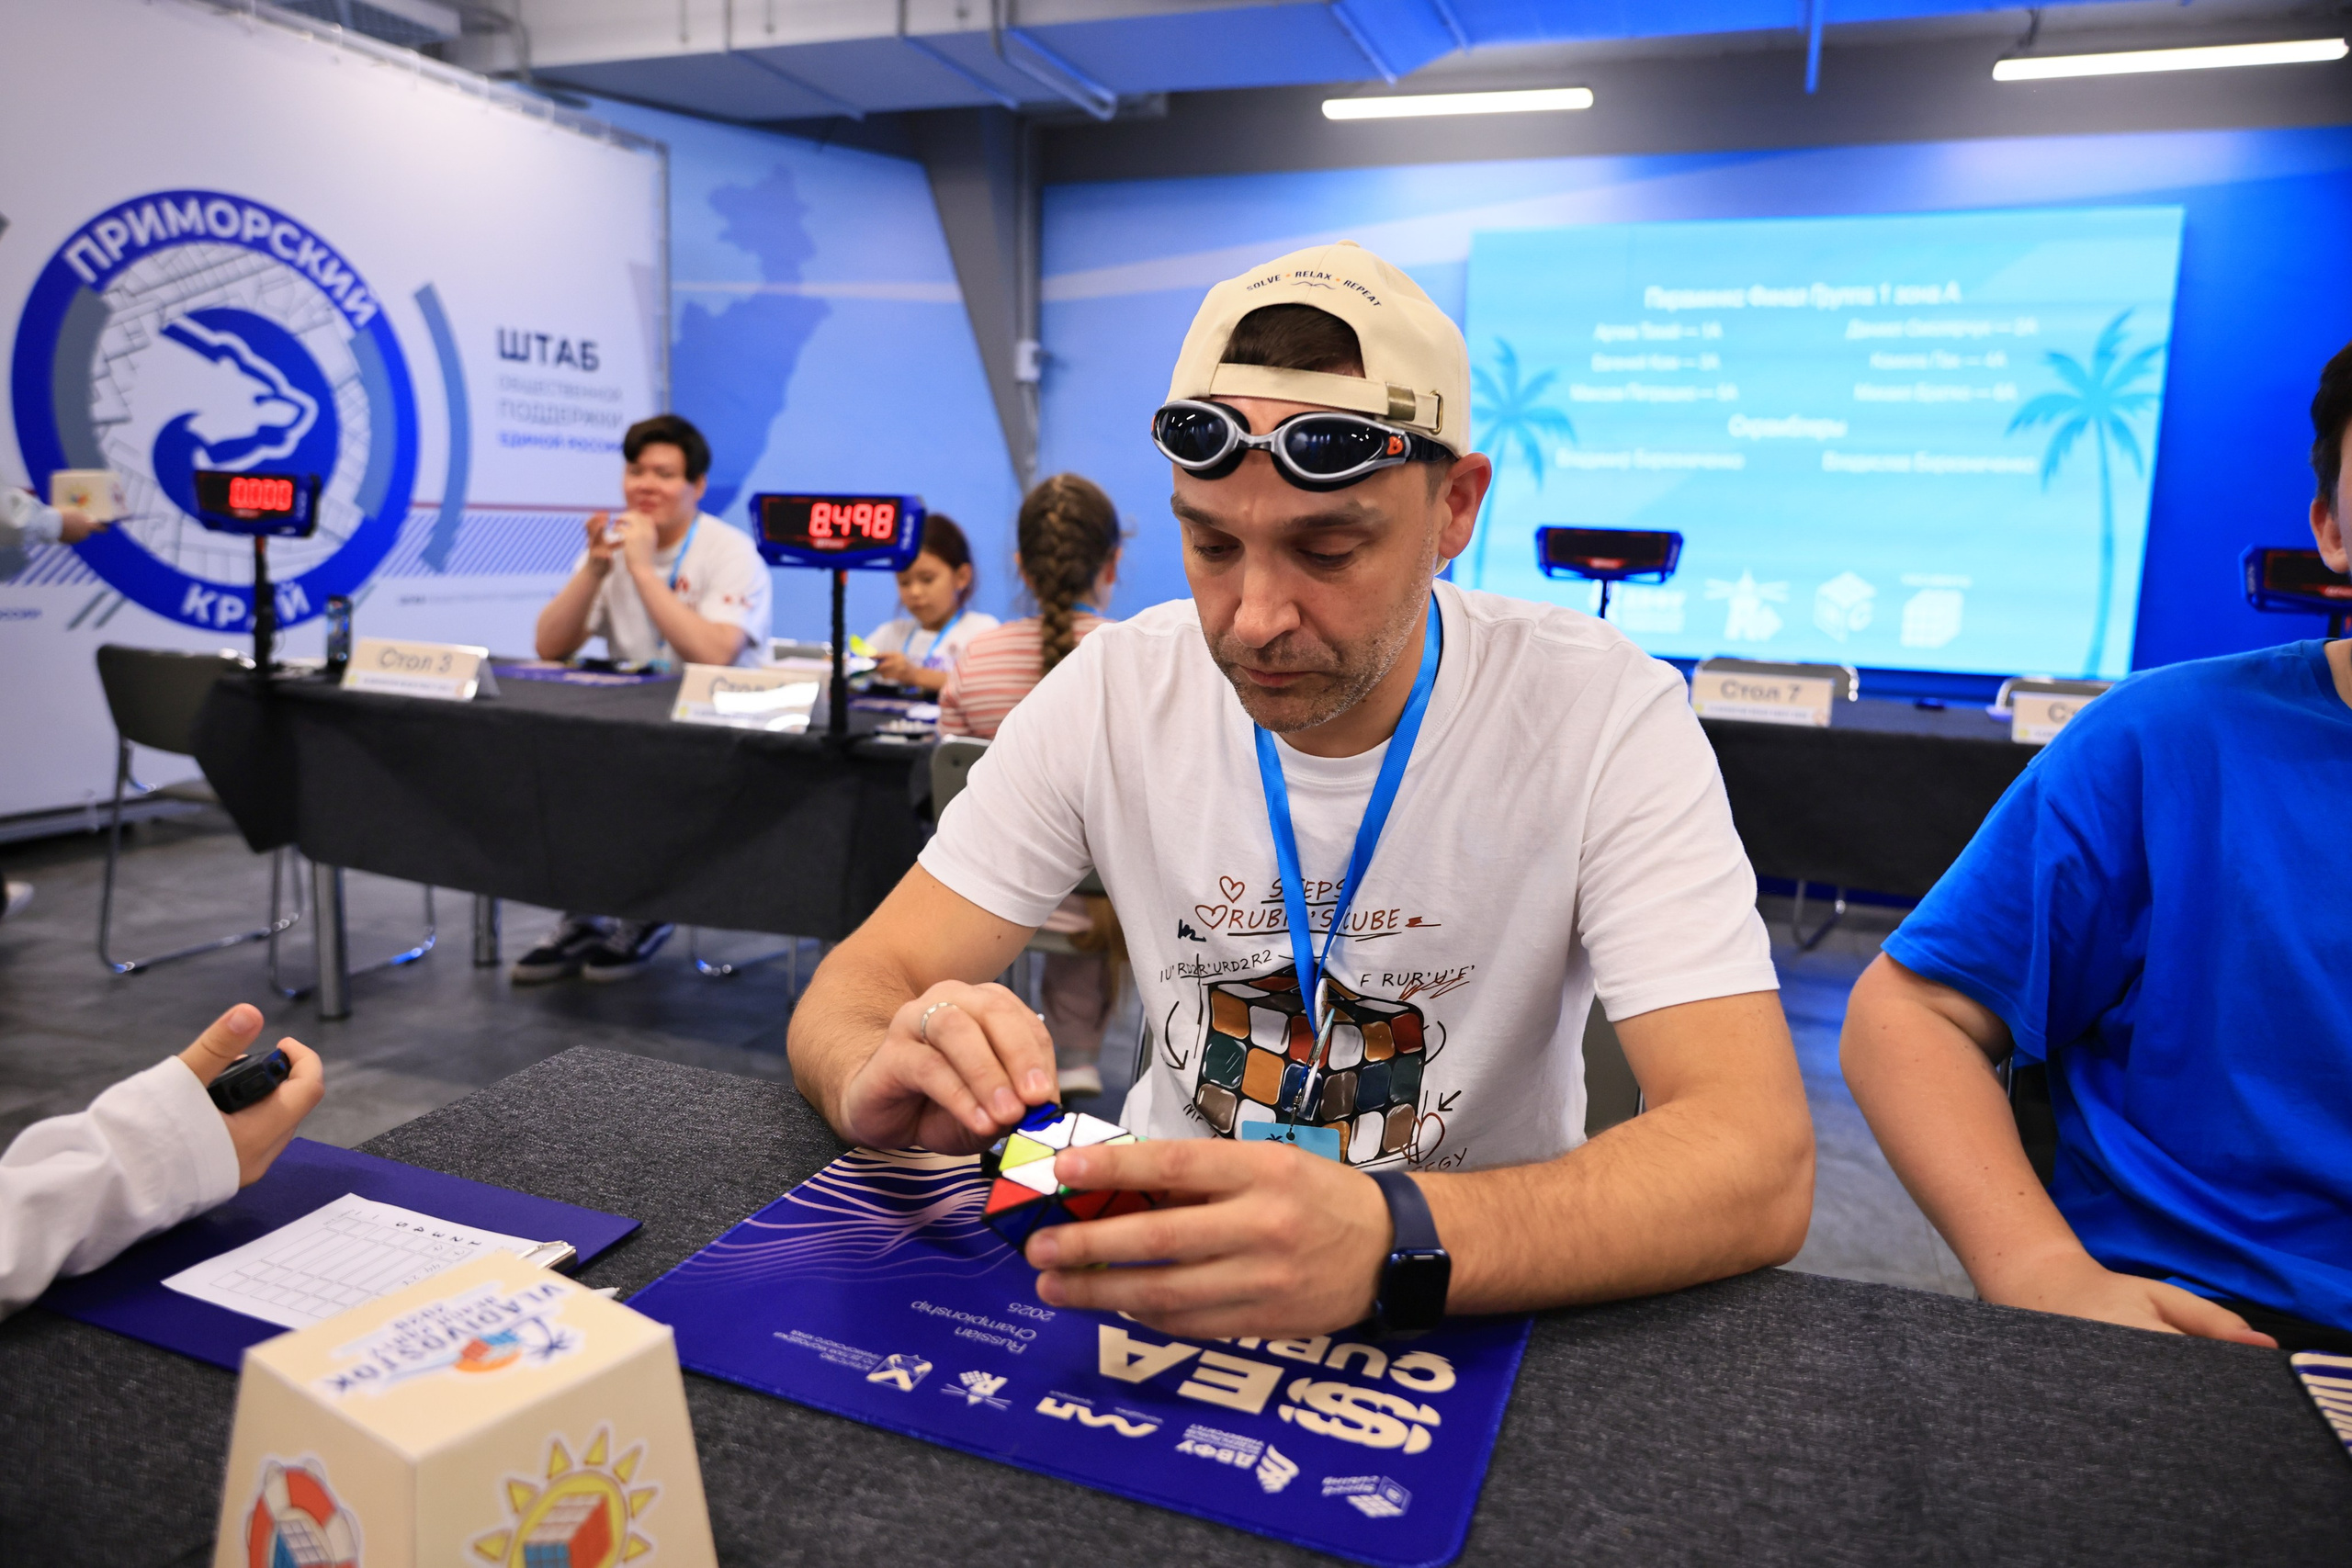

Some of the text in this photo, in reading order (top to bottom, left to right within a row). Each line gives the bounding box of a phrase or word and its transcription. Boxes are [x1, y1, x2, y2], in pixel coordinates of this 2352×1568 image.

[63, 197, 380, 328] ПРИМОРСКИЙ
[1247, 269, 1382, 307] SOLVE RELAX REPEAT
[497, 327, 600, 371] ШТАБ
[808, 502, 895, 539] 8.498
[183, 581, 311, 629] КРЙ
[377, 646, 453, 672] Стол 3
[1720, 679, 1803, 703] Стол 7
[1269, 878, 1346, 900] SEPS
[1228, 908, 1334, 930] RUBI'S
[1412, 1147, 1467, 1172] EGY
[909, 1298, 1038, 1341] Championship
[1006, 1300, 1056, 1322] 2025
[329, 1283, 562, 1394] VLADIVOSTOK
[953, 1325, 1027, 1355] Russian
[1117, 1311, 1456, 1393] CUB
[1098, 1324, 1442, 1452] SEA
[1173, 1437, 1258, 1470] ДВФУ
